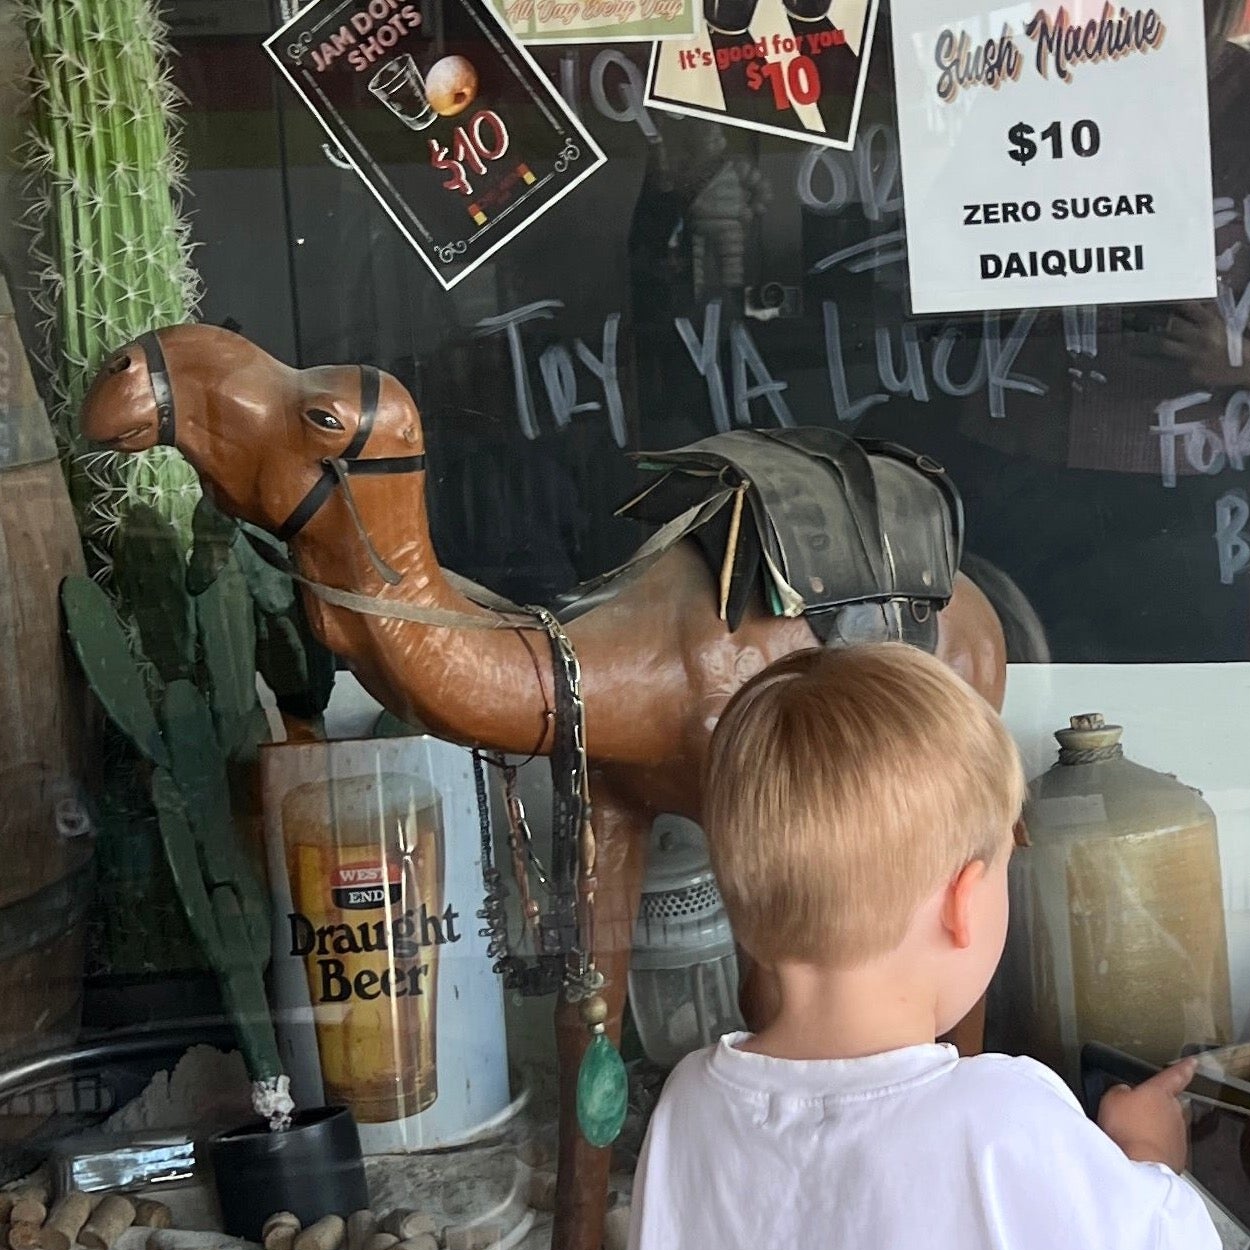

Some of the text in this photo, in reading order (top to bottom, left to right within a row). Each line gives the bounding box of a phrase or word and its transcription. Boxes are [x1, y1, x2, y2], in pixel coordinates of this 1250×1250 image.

[310, 0, 398, 72] JAM DO
[506, 2, 534, 23] All
[348, 5, 422, 71] SHOTS
[678, 29, 845, 70] It's good for you
[935, 5, 1167, 104] Slush Machine
[745, 55, 822, 111] $10
[428, 110, 509, 195] $10
[1007, 118, 1101, 166] $10
[963, 193, 1155, 226] ZERO SUGAR
[979, 244, 1145, 280] DAIQUIRI
[475, 300, 627, 448] TRY
[675, 301, 798, 433] YA
[337, 867, 386, 884] WEST
[347, 890, 385, 904] END
[287, 903, 461, 958] Draught
[318, 959, 430, 1002] Beer
